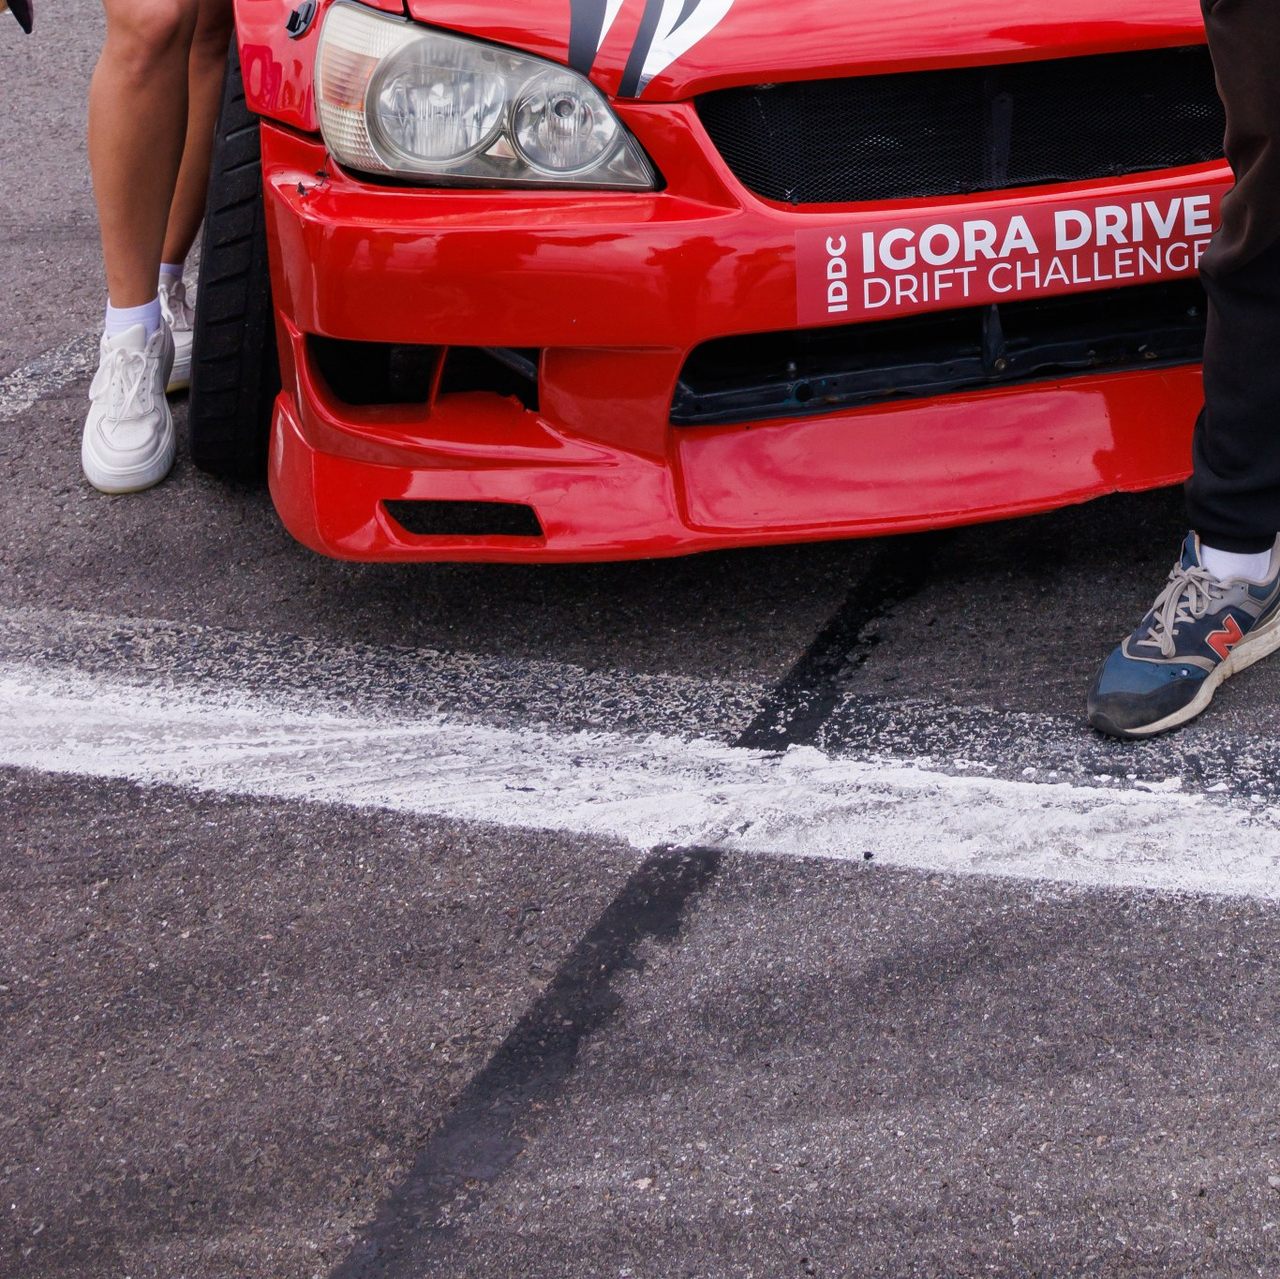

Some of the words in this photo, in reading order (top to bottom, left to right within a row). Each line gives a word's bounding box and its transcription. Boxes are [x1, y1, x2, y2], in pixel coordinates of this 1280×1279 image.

[860, 214, 1040, 273] IGORA
[1053, 194, 1213, 248] DRIVE
[825, 234, 849, 313] IDDC
[862, 265, 978, 309] DRIFT
